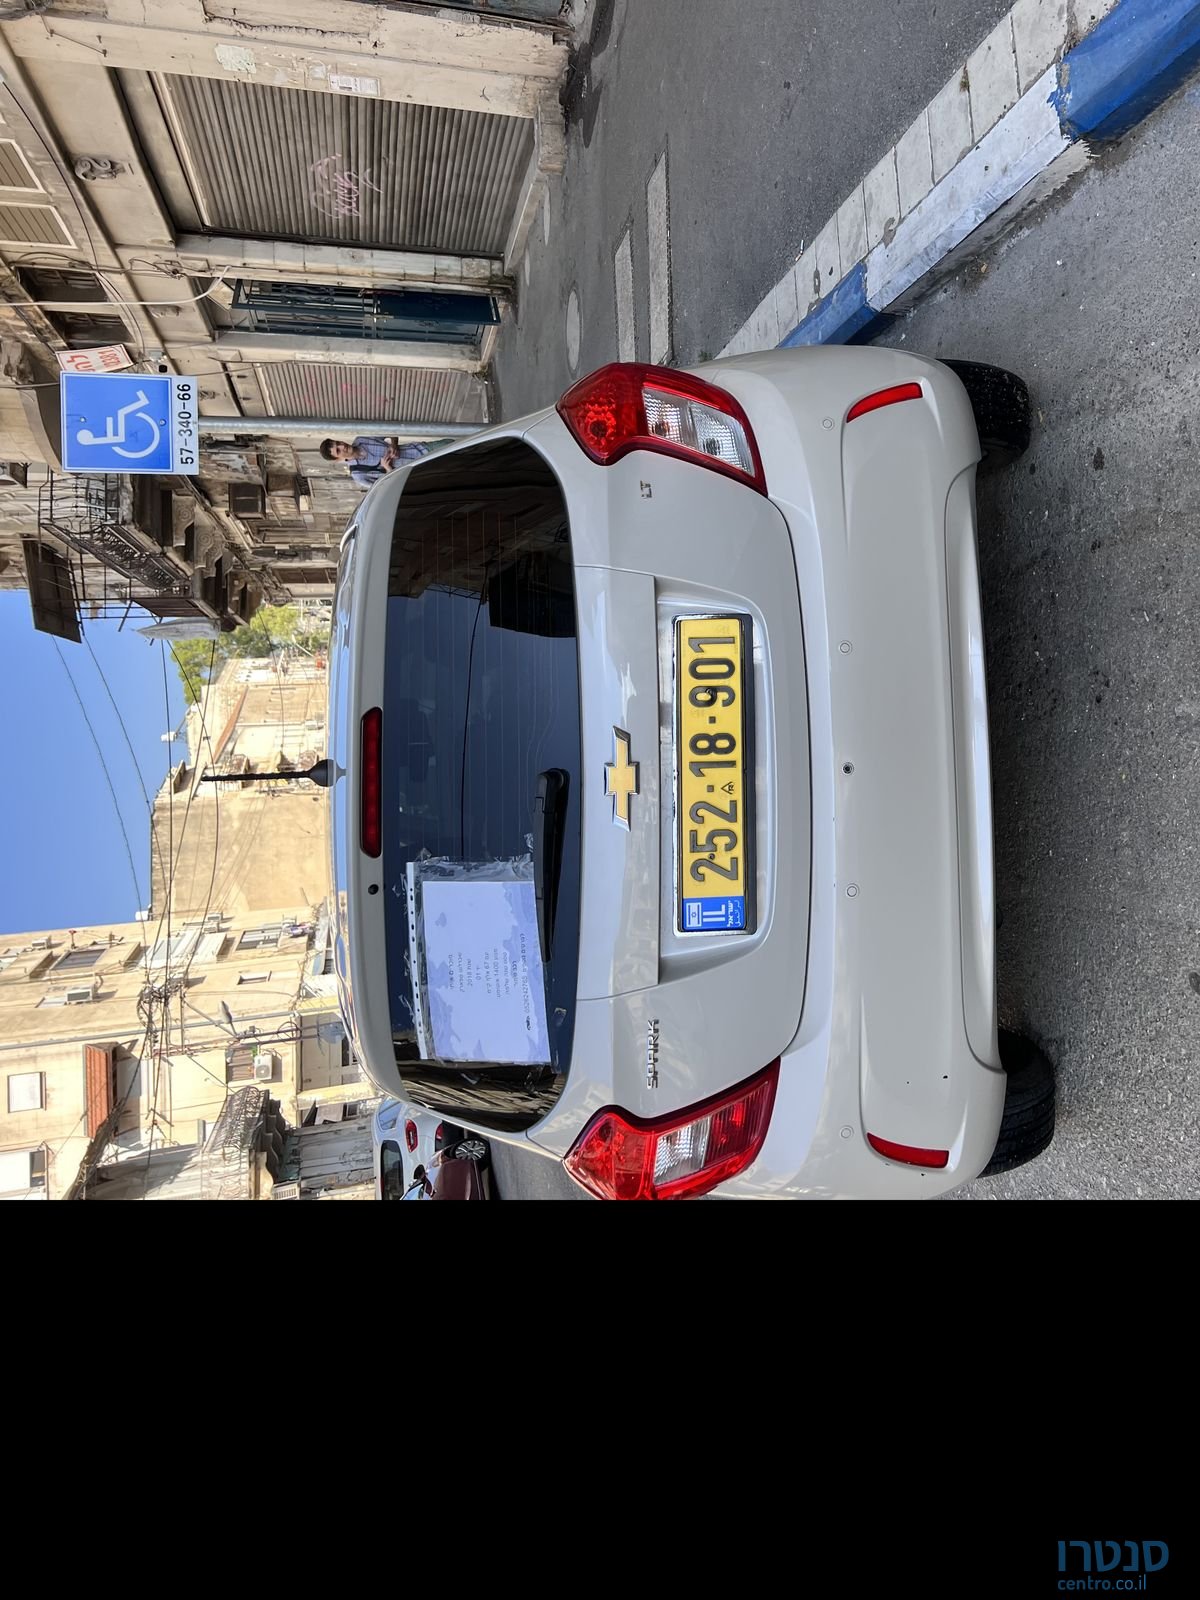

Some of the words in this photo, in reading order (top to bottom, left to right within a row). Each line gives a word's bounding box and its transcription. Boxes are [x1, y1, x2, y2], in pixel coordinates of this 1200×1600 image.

[176, 383, 195, 465] 57-340-66
[640, 480, 653, 500] LT
[702, 904, 726, 922] IL
[646, 1019, 660, 1090] SPARK
